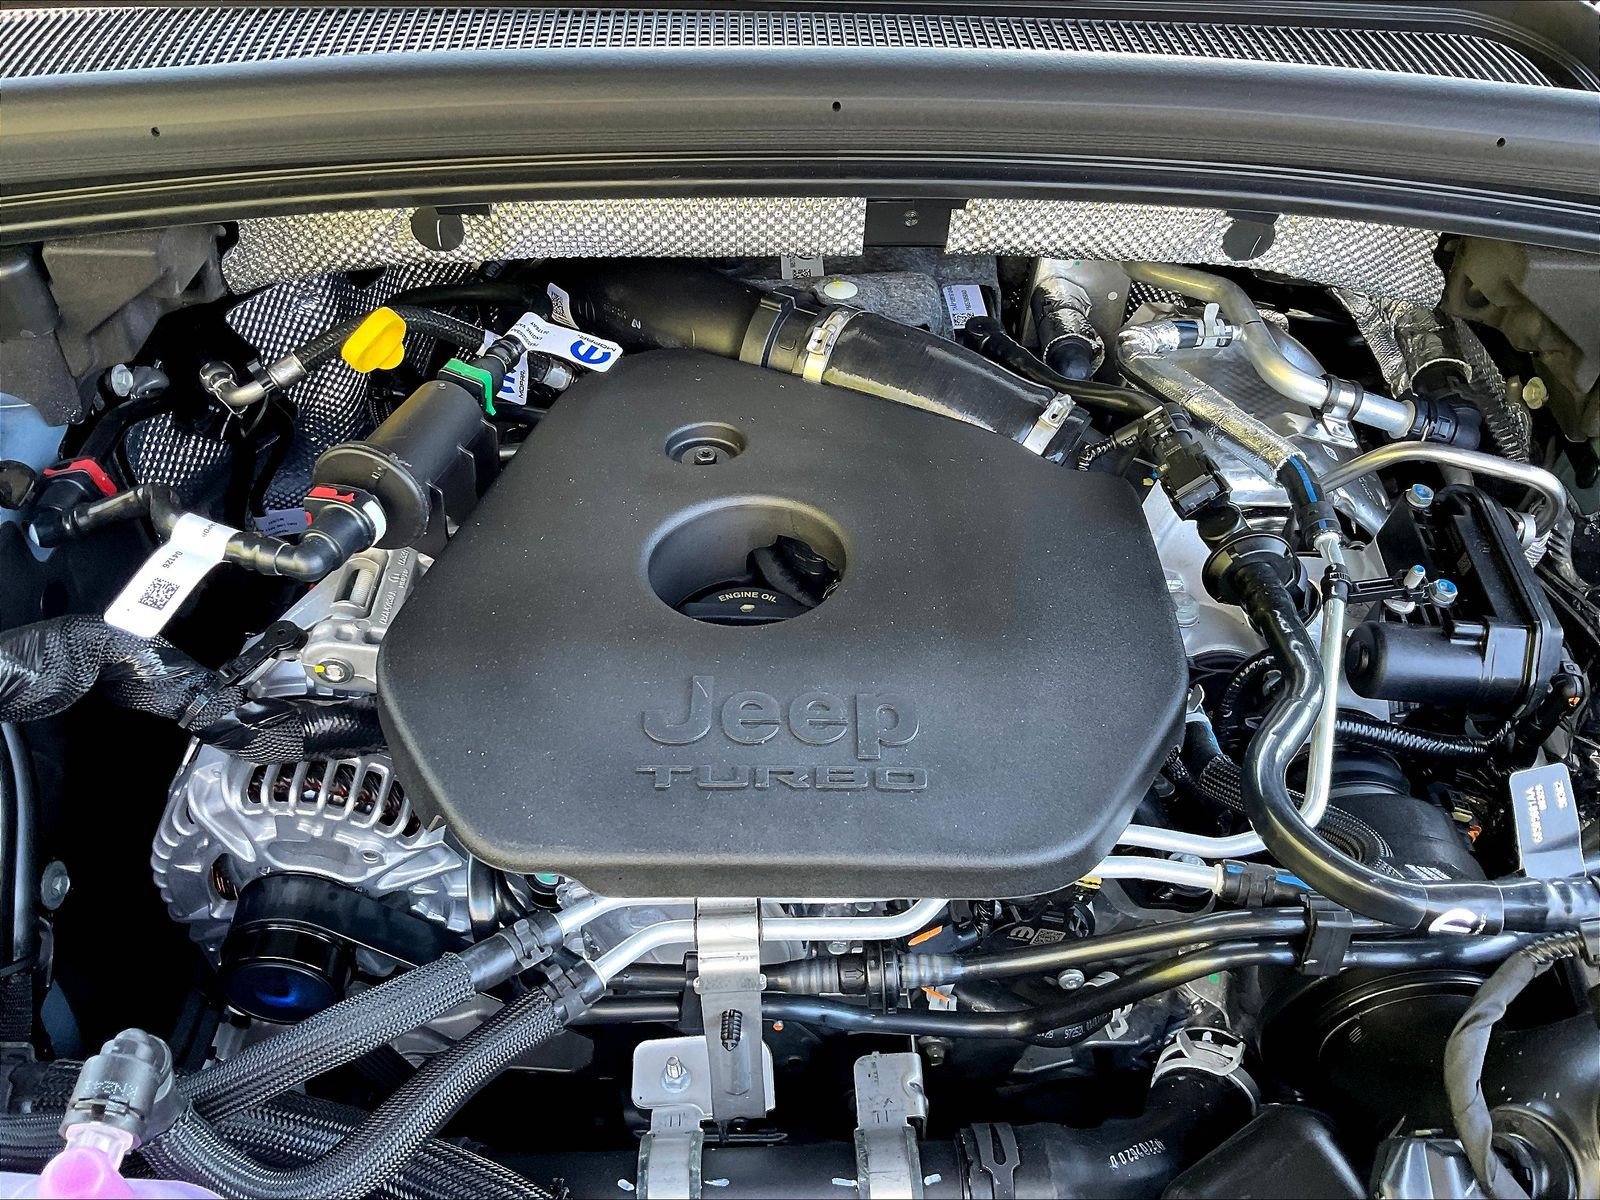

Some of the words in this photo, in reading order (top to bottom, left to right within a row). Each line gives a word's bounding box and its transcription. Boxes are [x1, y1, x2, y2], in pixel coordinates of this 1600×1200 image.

[577, 334, 618, 352] MOPAR
[518, 369, 526, 399] MOPAR
[162, 550, 184, 569] 04126
[718, 591, 759, 602] ENGINE
[761, 593, 777, 603] OIL
[641, 675, 922, 761] Jeep
[635, 764, 928, 792] TURBO
